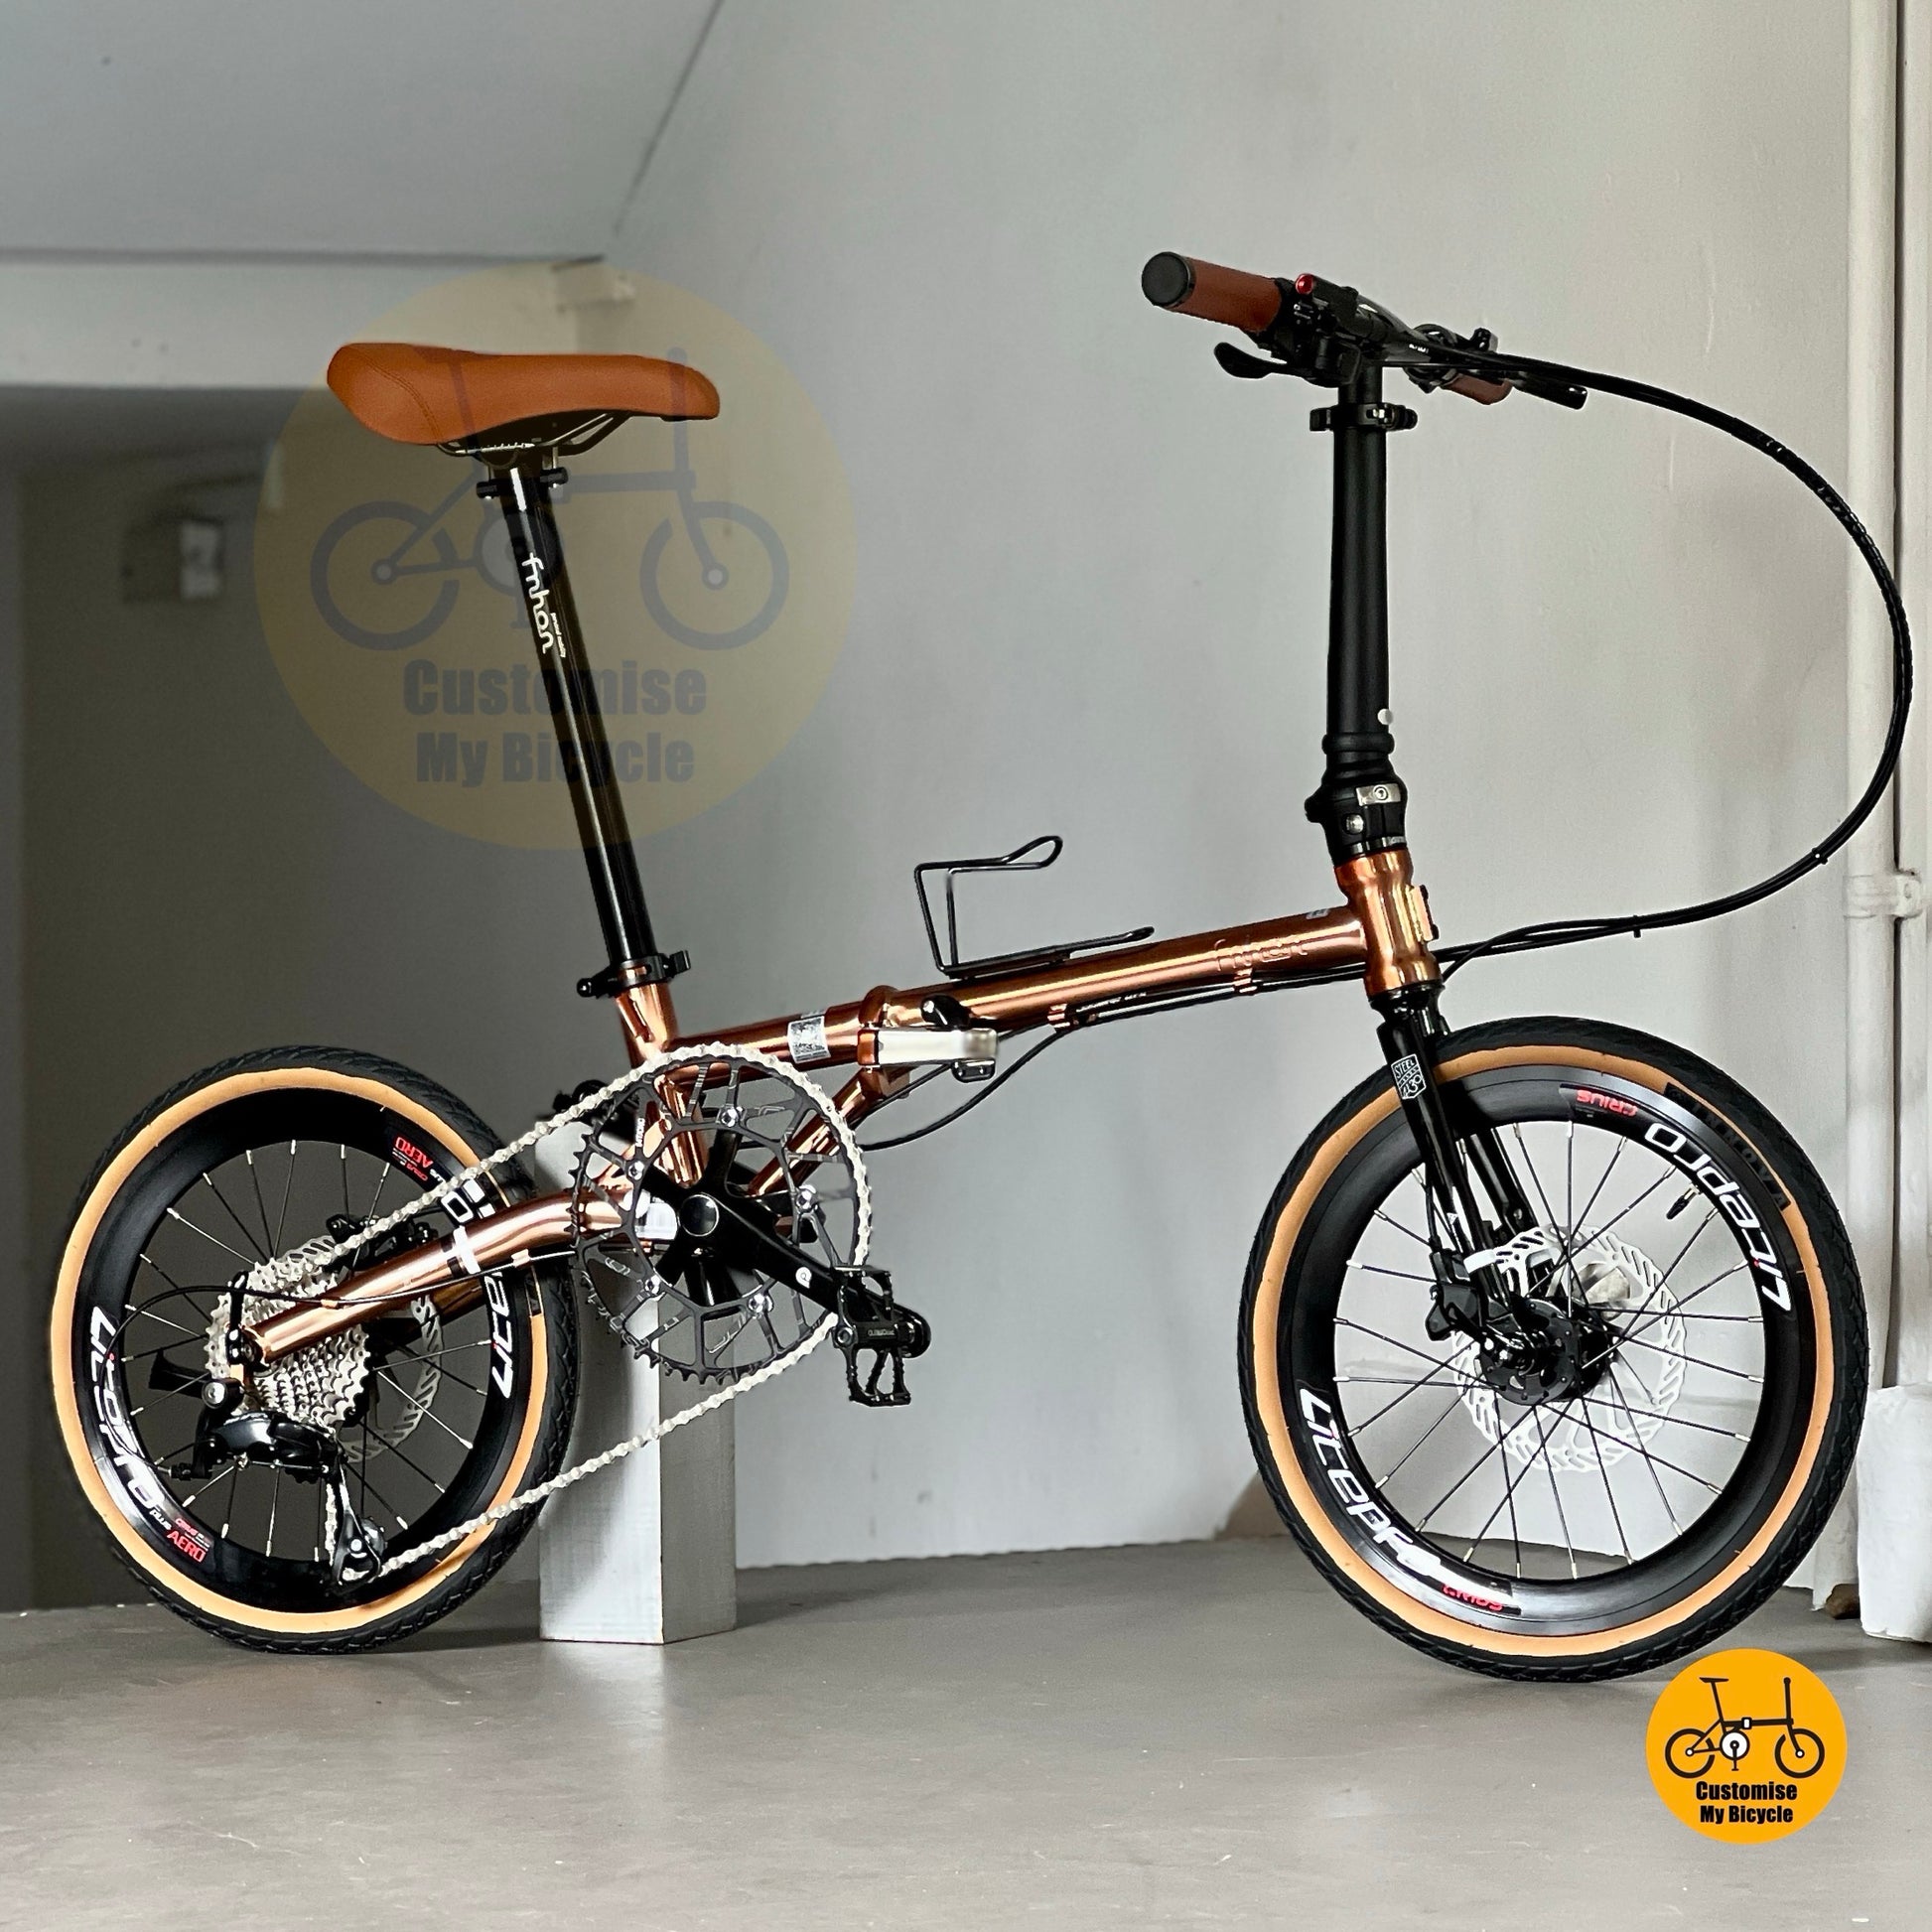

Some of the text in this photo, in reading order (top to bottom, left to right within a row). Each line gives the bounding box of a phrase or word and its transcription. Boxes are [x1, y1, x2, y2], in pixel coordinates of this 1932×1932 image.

[1577, 1089, 1638, 1117] CRIUS
[395, 1136, 434, 1170] AERO
[167, 1530, 207, 1563] AERO
